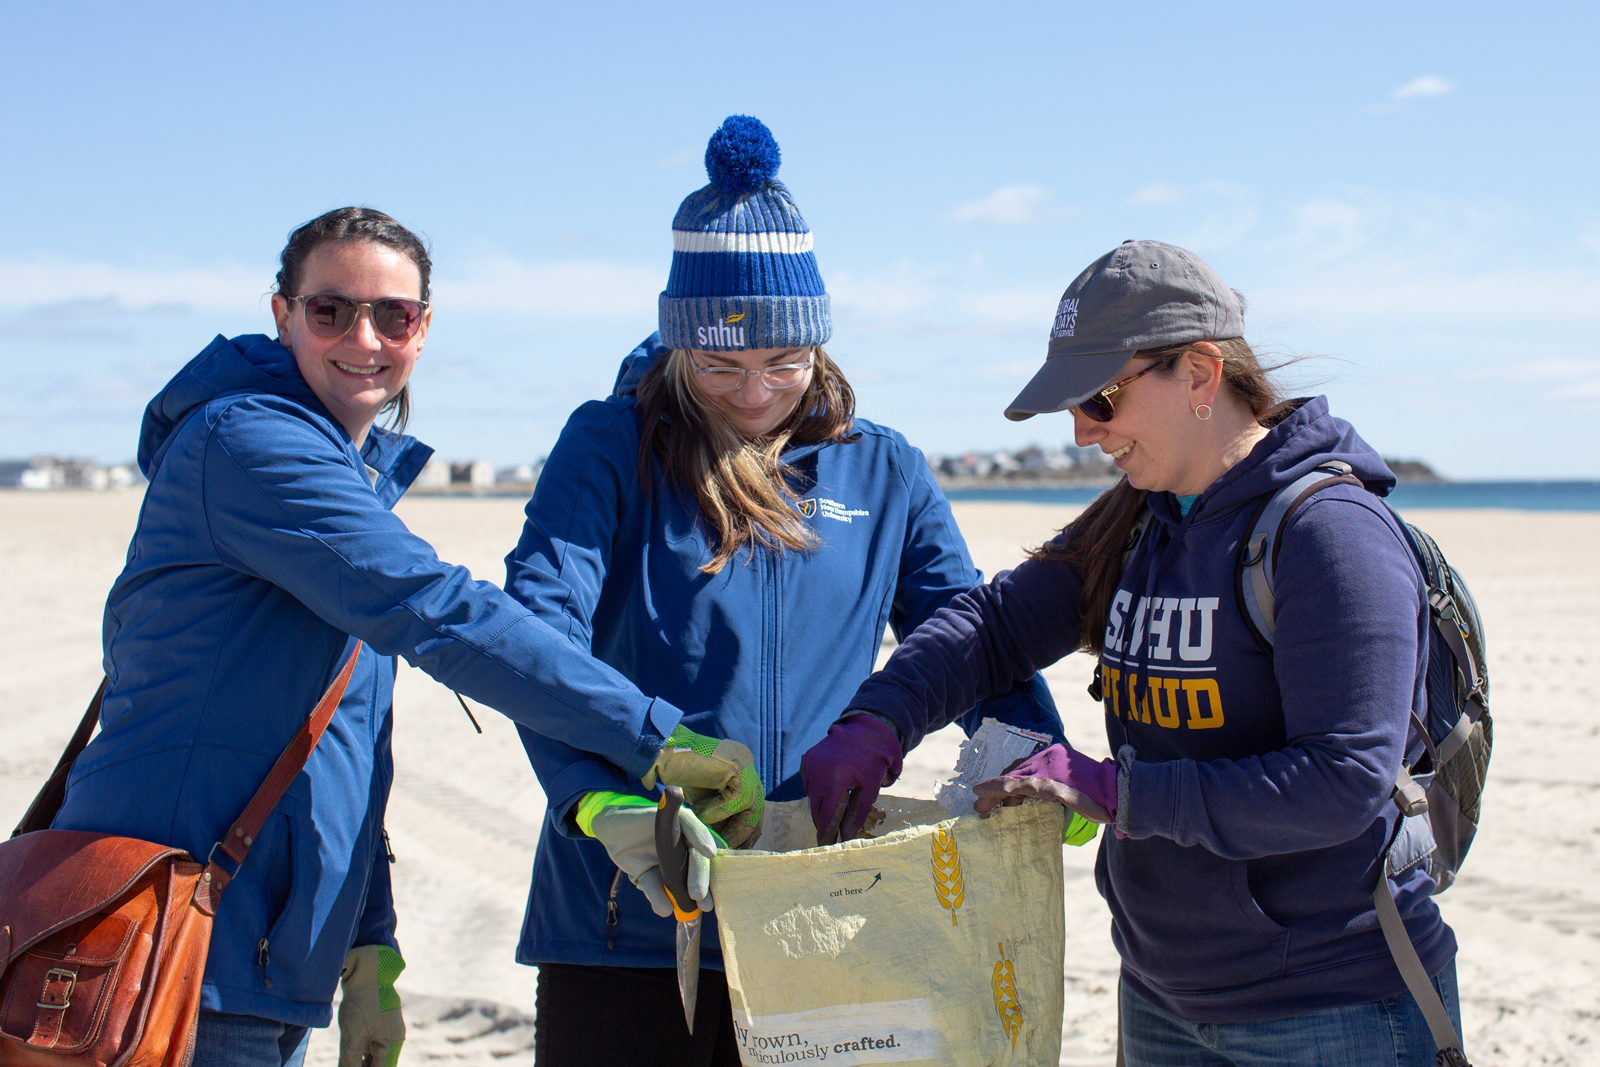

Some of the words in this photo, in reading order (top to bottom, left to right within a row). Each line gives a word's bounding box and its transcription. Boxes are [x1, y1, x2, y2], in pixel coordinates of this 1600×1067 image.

[1055, 313, 1077, 330] DAYS
[698, 318, 745, 347] snhu
[821, 510, 852, 523] University
[834, 507, 870, 517] Hampshire
[829, 889, 843, 897] cut
[844, 887, 863, 896] here
[833, 1034, 901, 1054] crafted.
